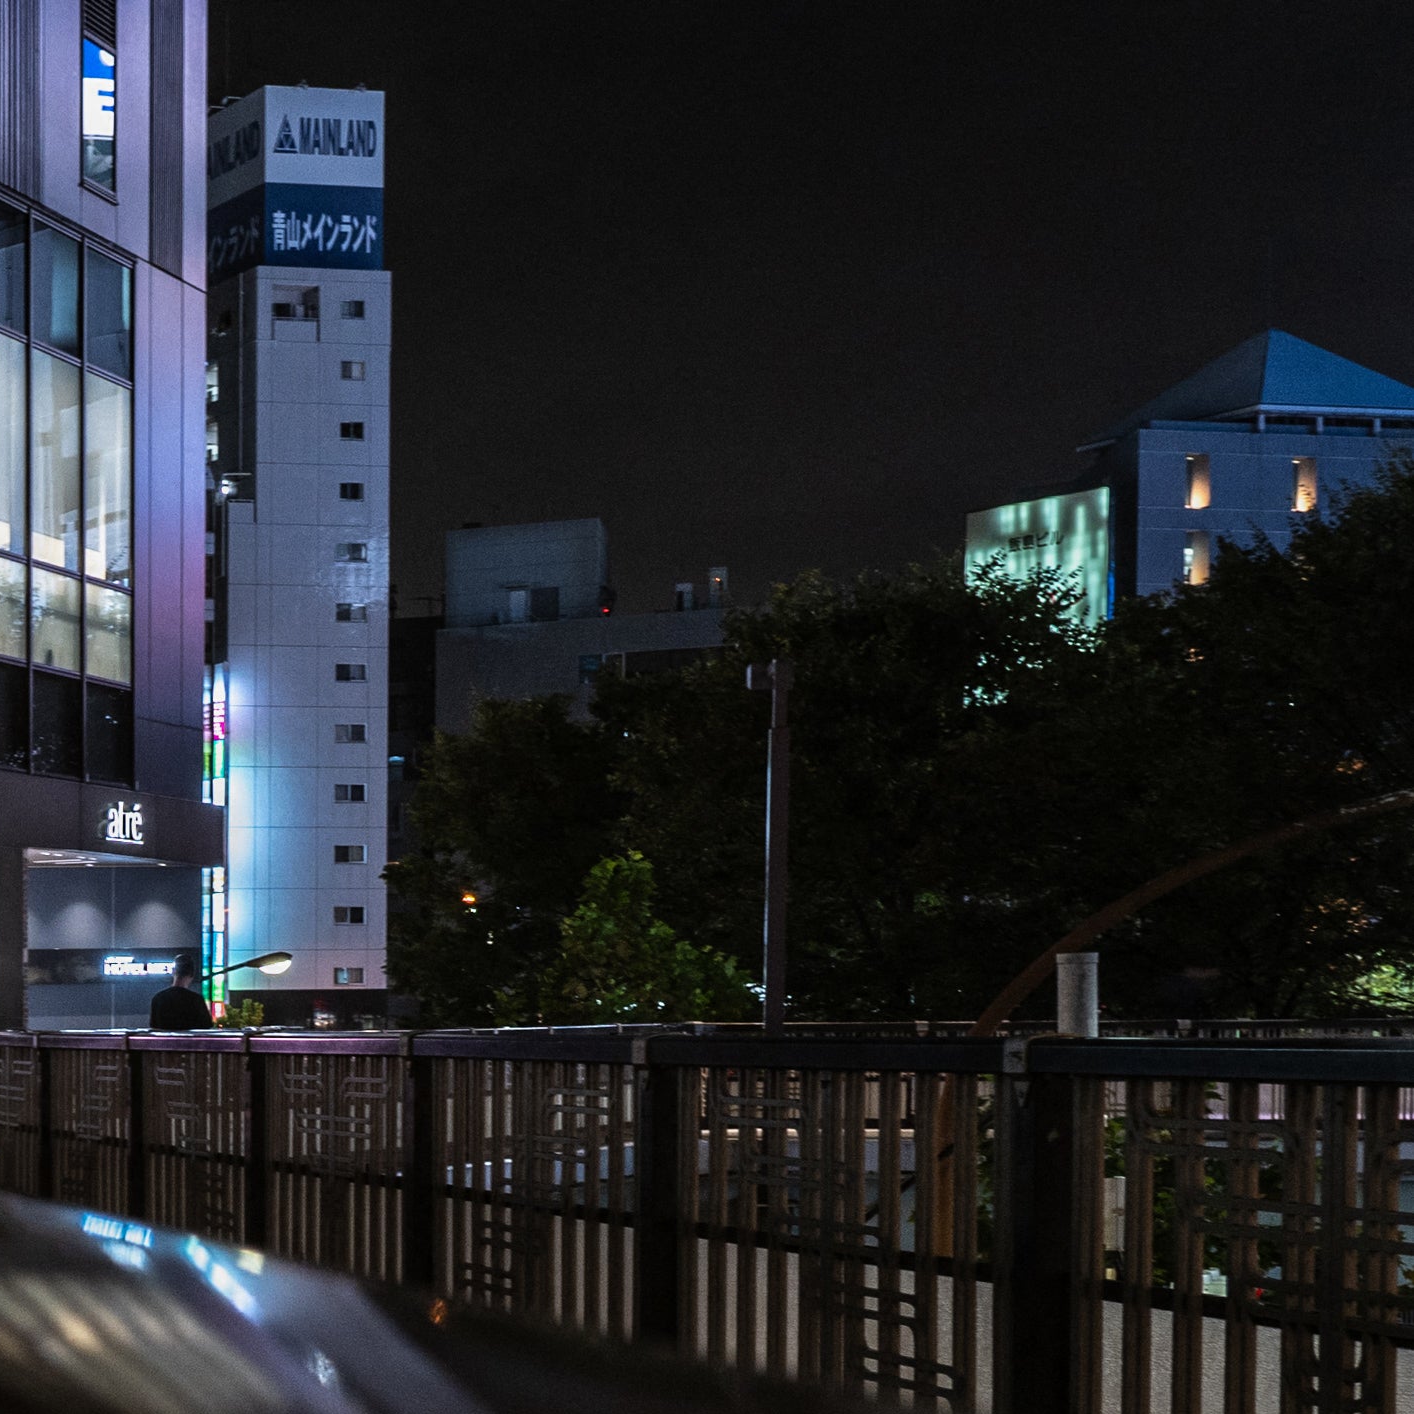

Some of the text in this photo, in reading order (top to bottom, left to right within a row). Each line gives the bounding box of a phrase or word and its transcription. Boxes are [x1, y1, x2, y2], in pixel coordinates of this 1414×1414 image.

[299, 117, 377, 157] MAINLAND
[272, 211, 377, 253] 青山メインランド
[106, 801, 144, 840] atré
